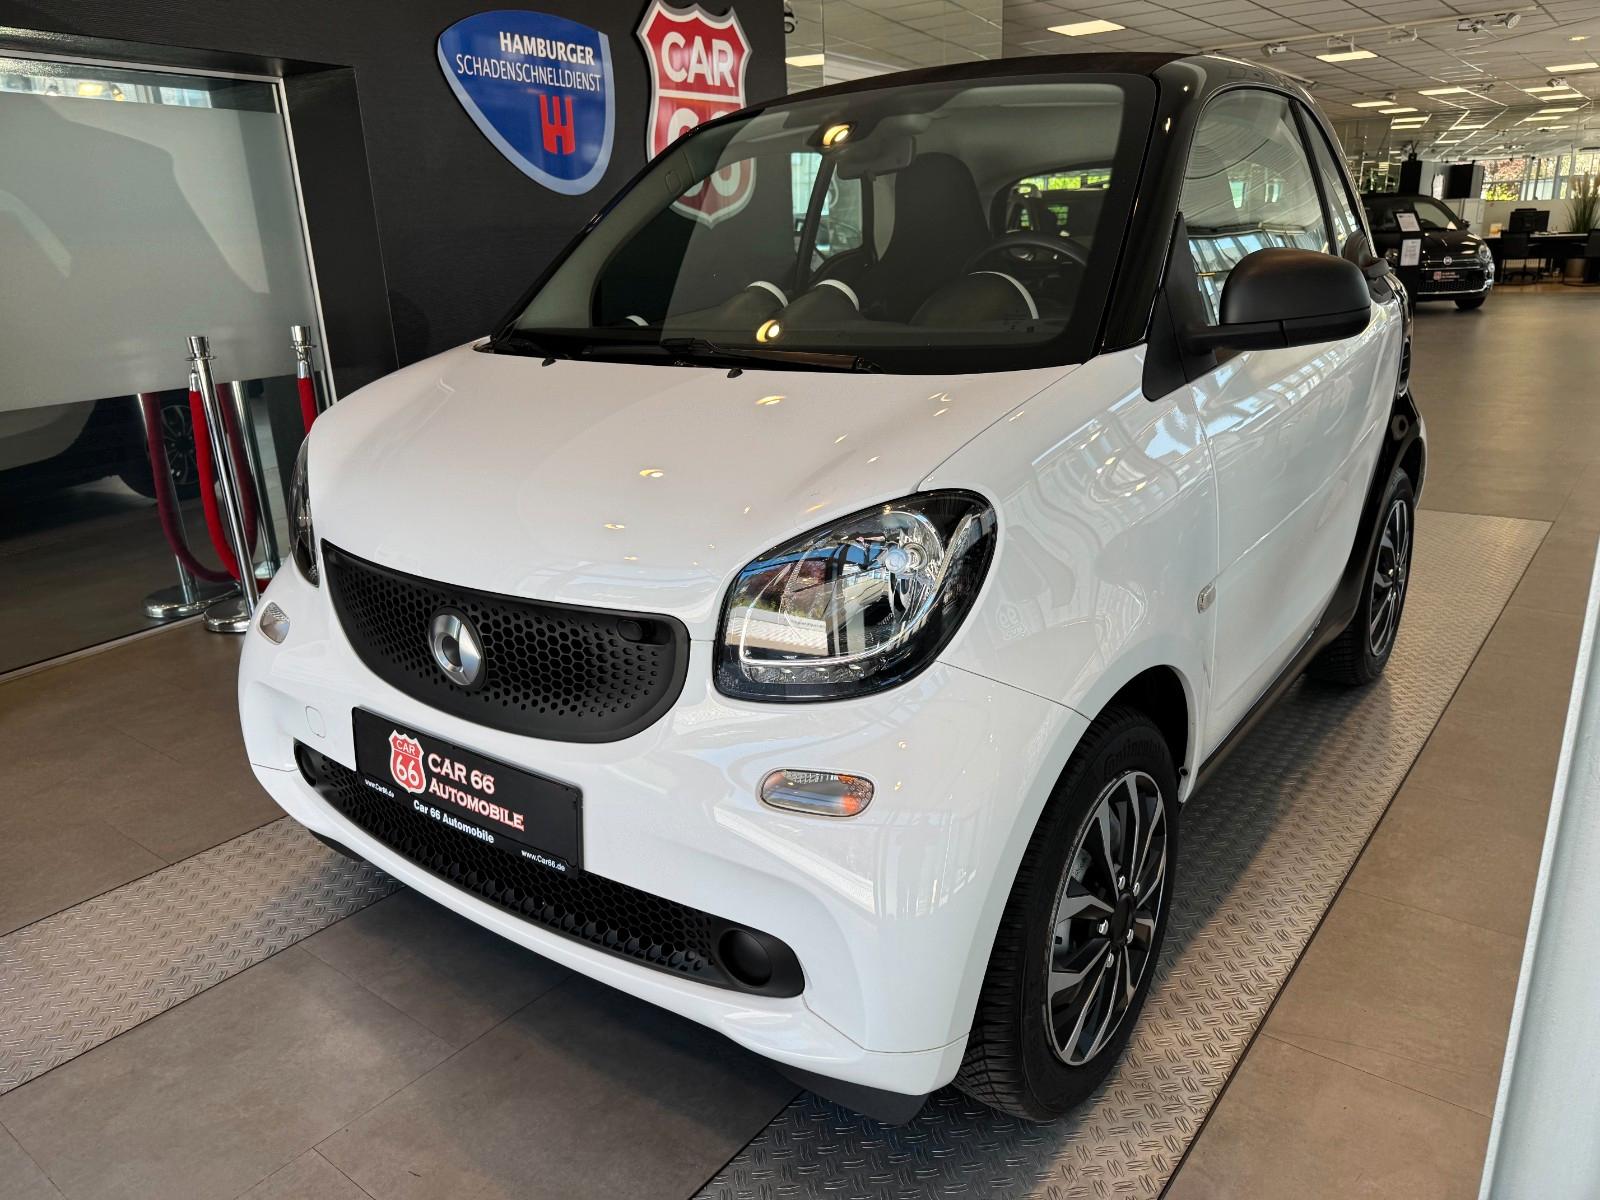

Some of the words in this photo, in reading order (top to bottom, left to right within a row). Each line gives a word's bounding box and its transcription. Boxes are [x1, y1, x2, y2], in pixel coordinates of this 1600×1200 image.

[499, 31, 596, 66] HAMBURGER
[661, 31, 735, 88] CAR
[456, 54, 601, 92] SCHADENSCHNELLDIENST
[396, 740, 416, 756] CAR
[396, 755, 420, 786] 66
[428, 753, 467, 785] CAR
[470, 769, 495, 795] 66
[413, 799, 429, 815] Car
[430, 807, 441, 821] 66
[442, 812, 495, 844] Automobile
[428, 777, 525, 832] AUTOMOBILE
